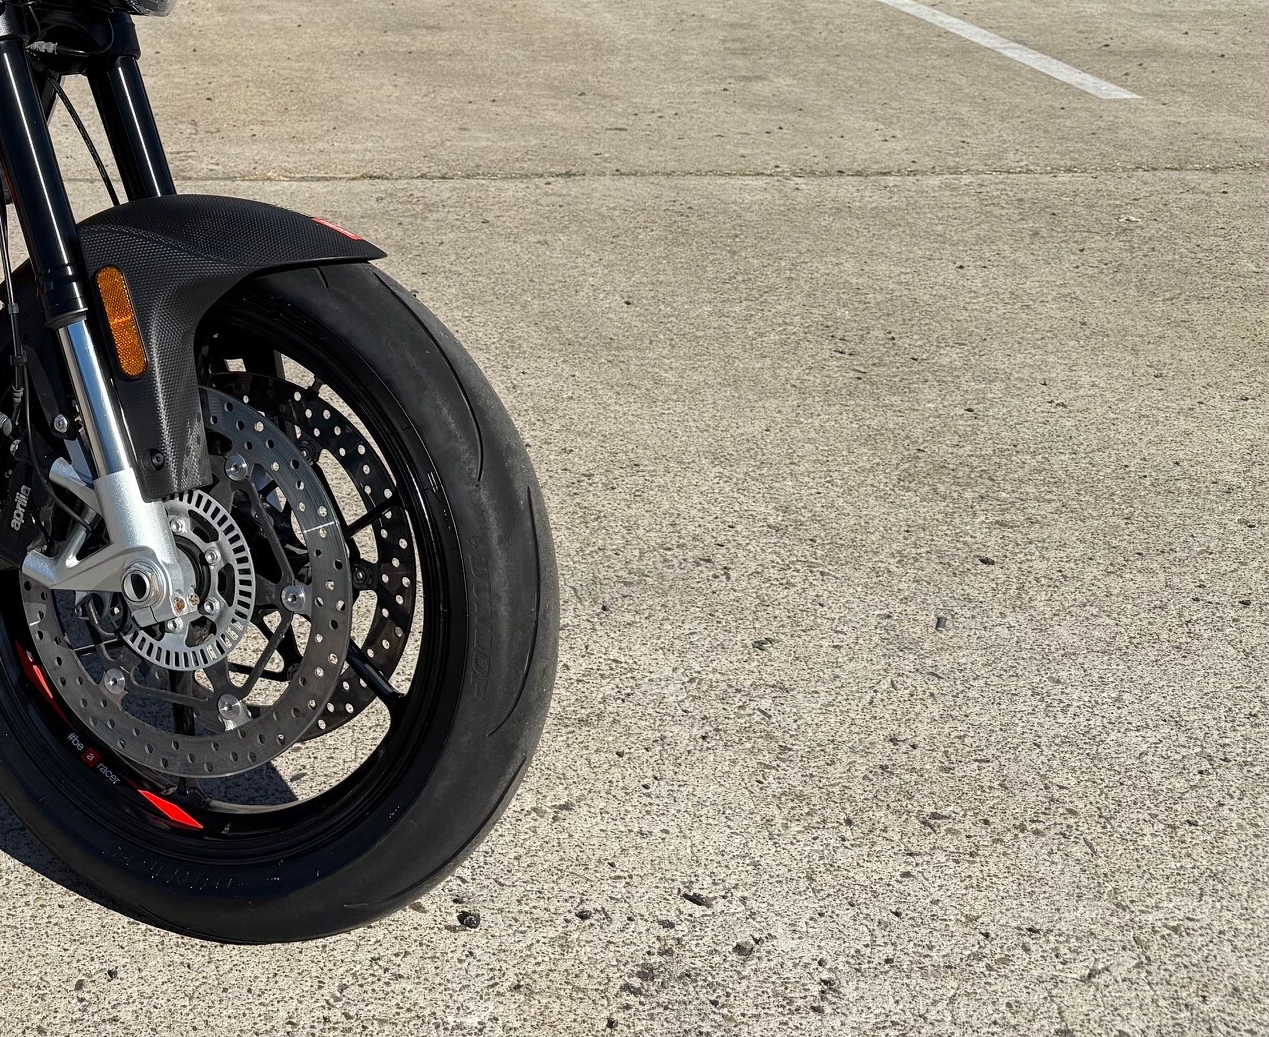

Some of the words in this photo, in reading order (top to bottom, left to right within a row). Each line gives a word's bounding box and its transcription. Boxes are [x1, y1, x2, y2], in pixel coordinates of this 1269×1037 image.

[11, 484, 32, 531] aprilia
[67, 732, 85, 751] #be
[86, 752, 95, 762] a
[96, 762, 121, 784] racer
